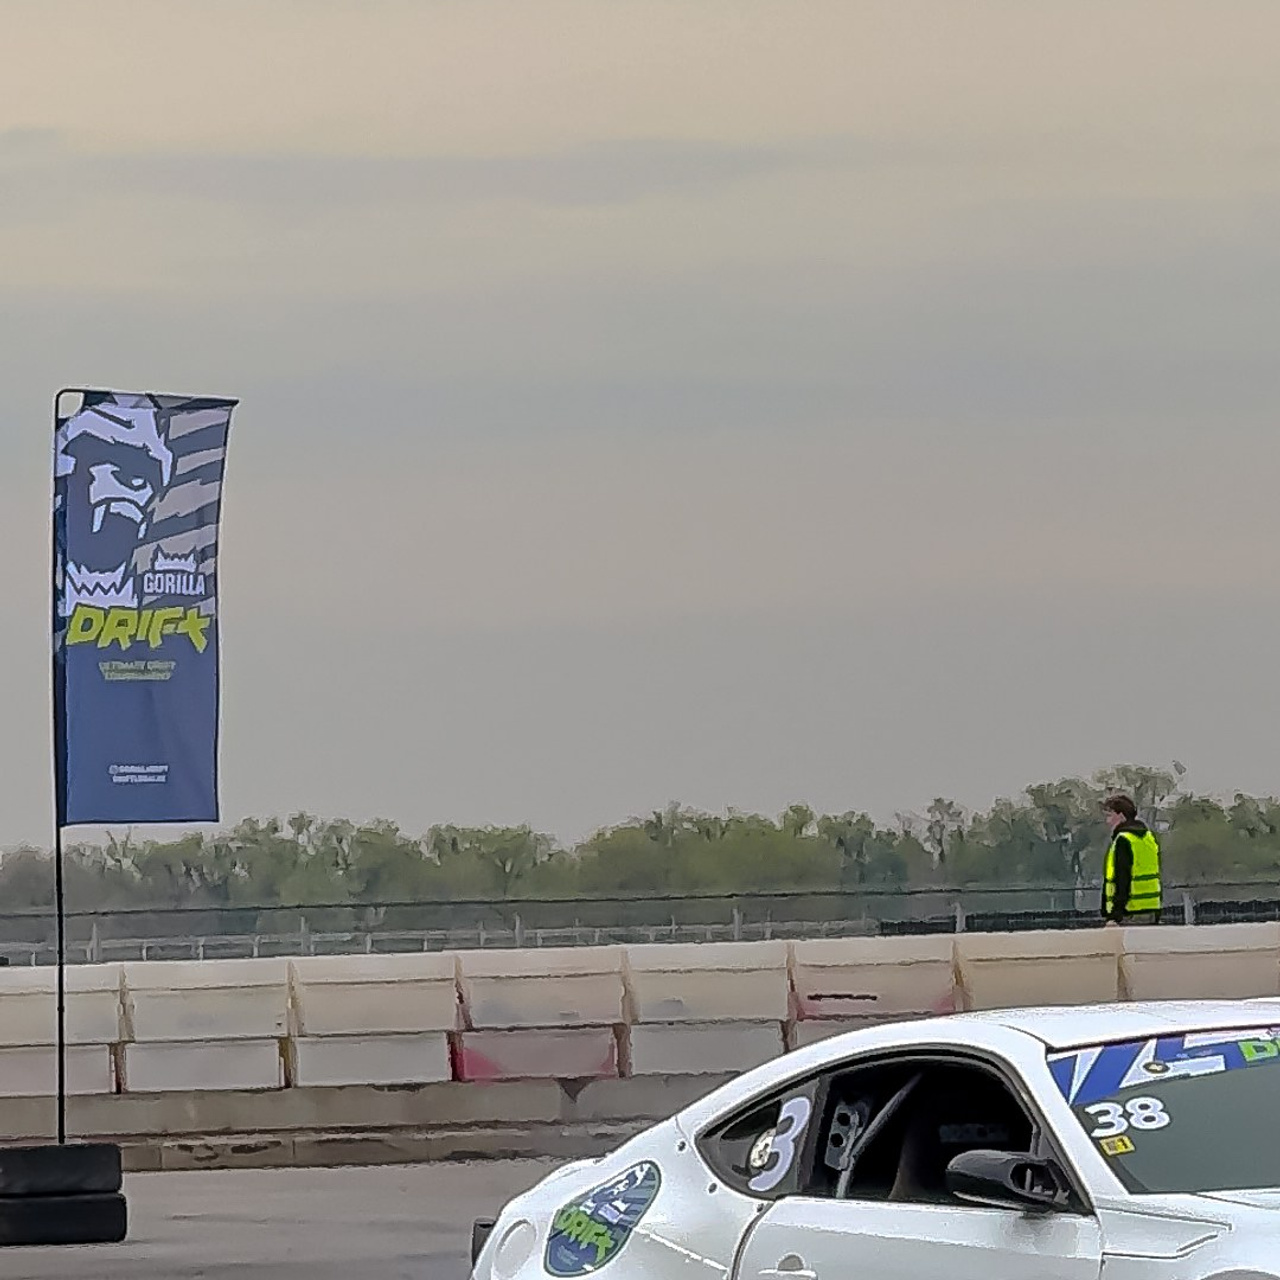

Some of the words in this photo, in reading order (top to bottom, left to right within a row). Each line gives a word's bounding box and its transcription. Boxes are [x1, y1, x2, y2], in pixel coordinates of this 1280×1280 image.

[143, 572, 206, 595] GORILLA
[66, 604, 211, 653] DRIFT
[1084, 1096, 1171, 1137] 38
